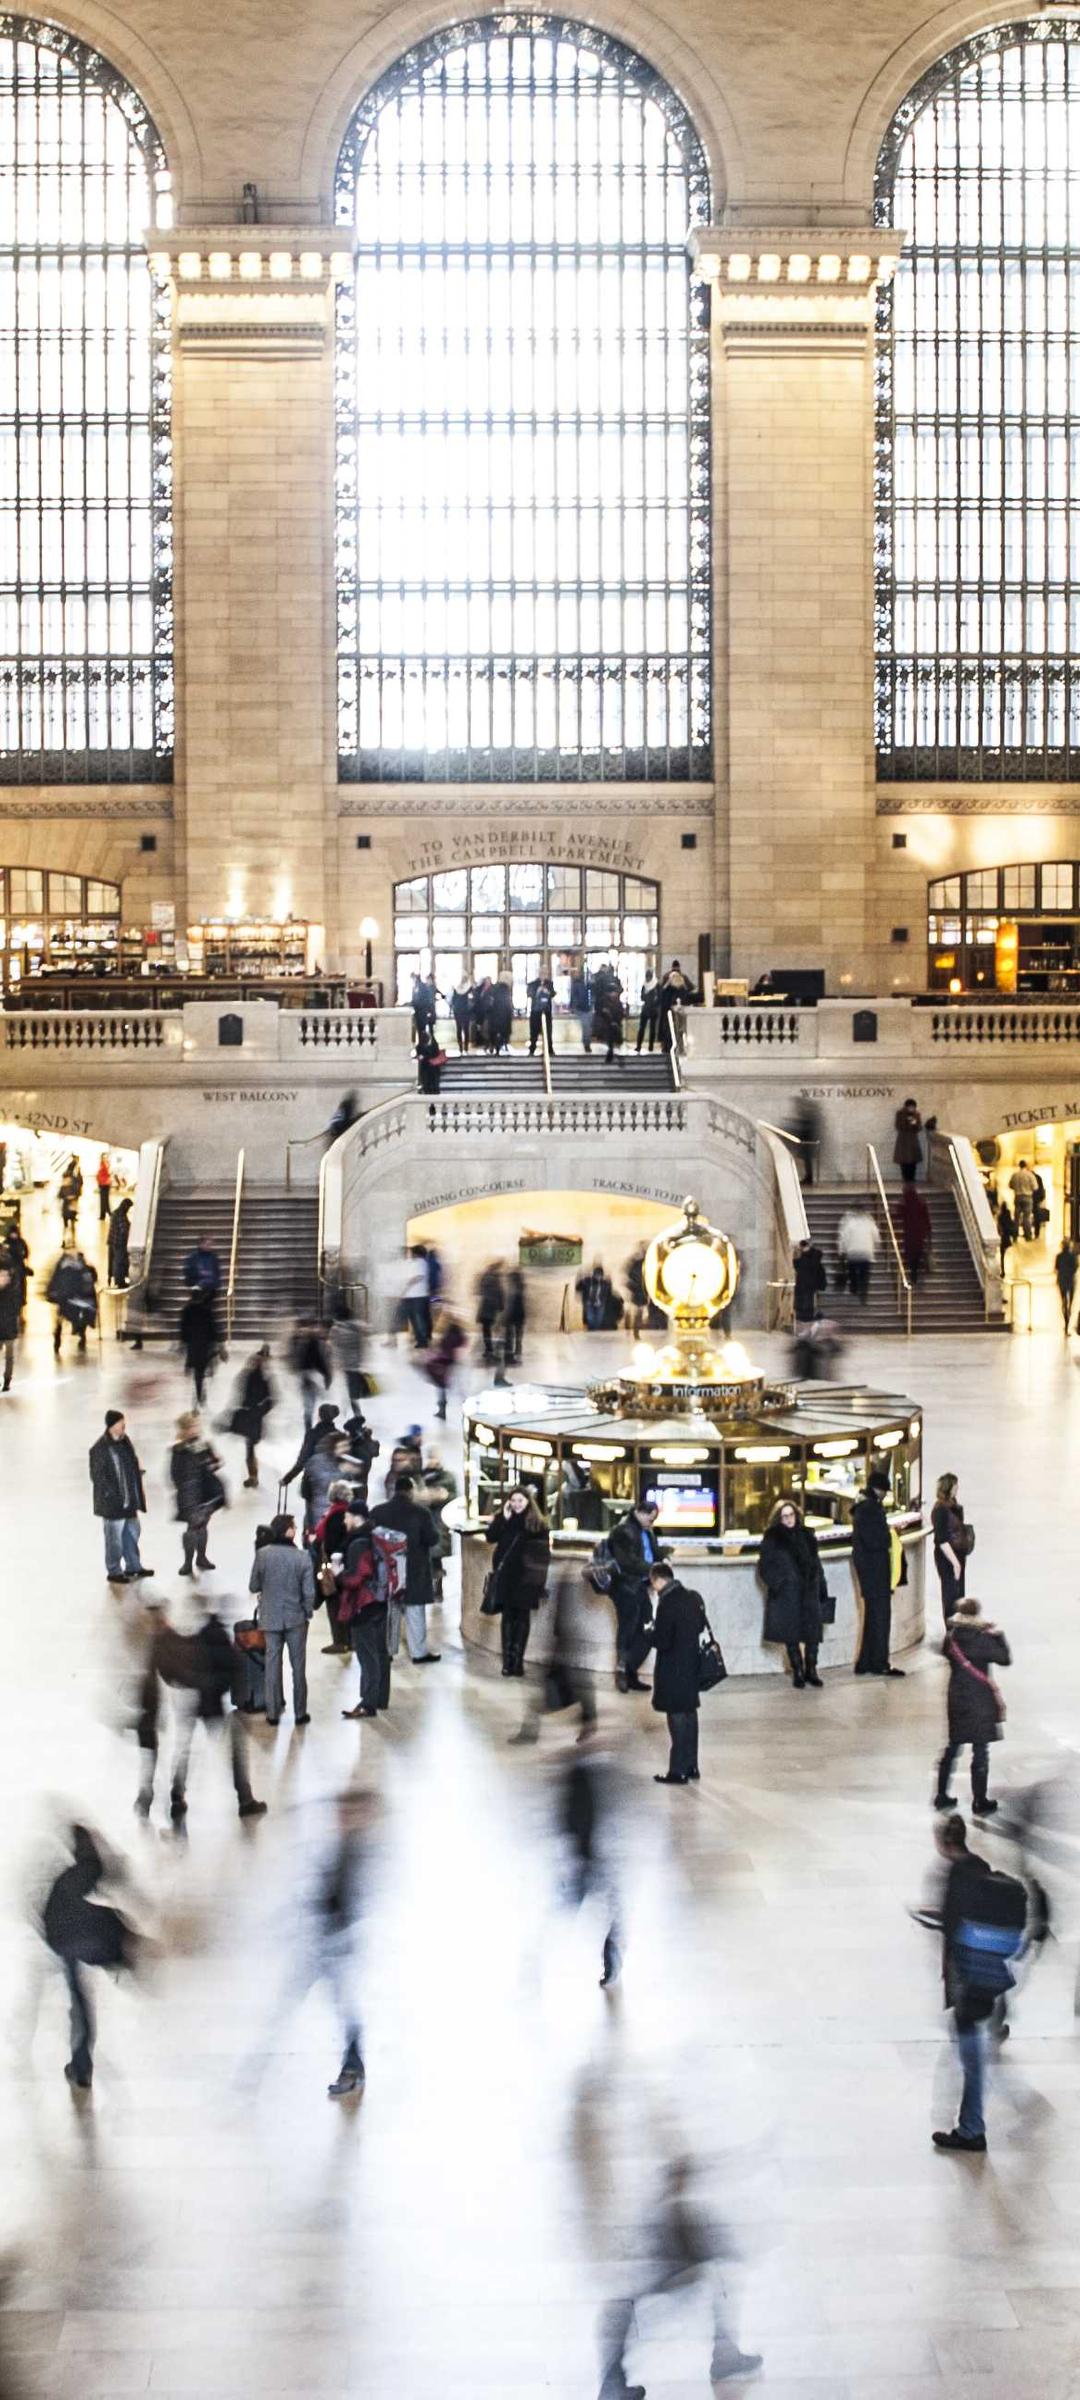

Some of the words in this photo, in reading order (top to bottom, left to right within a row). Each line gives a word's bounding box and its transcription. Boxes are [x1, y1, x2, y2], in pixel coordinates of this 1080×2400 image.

[421, 840, 443, 853] TO
[452, 831, 557, 847] VANDERBILT
[567, 833, 633, 853] AVENUE
[408, 854, 443, 871] THE
[451, 845, 536, 860] CAMPBELL
[547, 846, 645, 870] APARTMENT
[202, 1091, 237, 1102] WEST
[239, 1091, 298, 1102] BALCONY
[800, 1087, 833, 1098] WEST
[836, 1087, 895, 1098] BALCONY
[24, 1112, 68, 1129] 42ND
[72, 1119, 93, 1133] ST
[1001, 1105, 1058, 1127] TICKET
[1064, 1102, 1080, 1116] M
[413, 1190, 457, 1212] DINING
[458, 1179, 526, 1197] CONCOURSE
[592, 1178, 633, 1192] TRACKS
[654, 1188, 669, 1199] TO
[672, 1384, 742, 1398] Information
